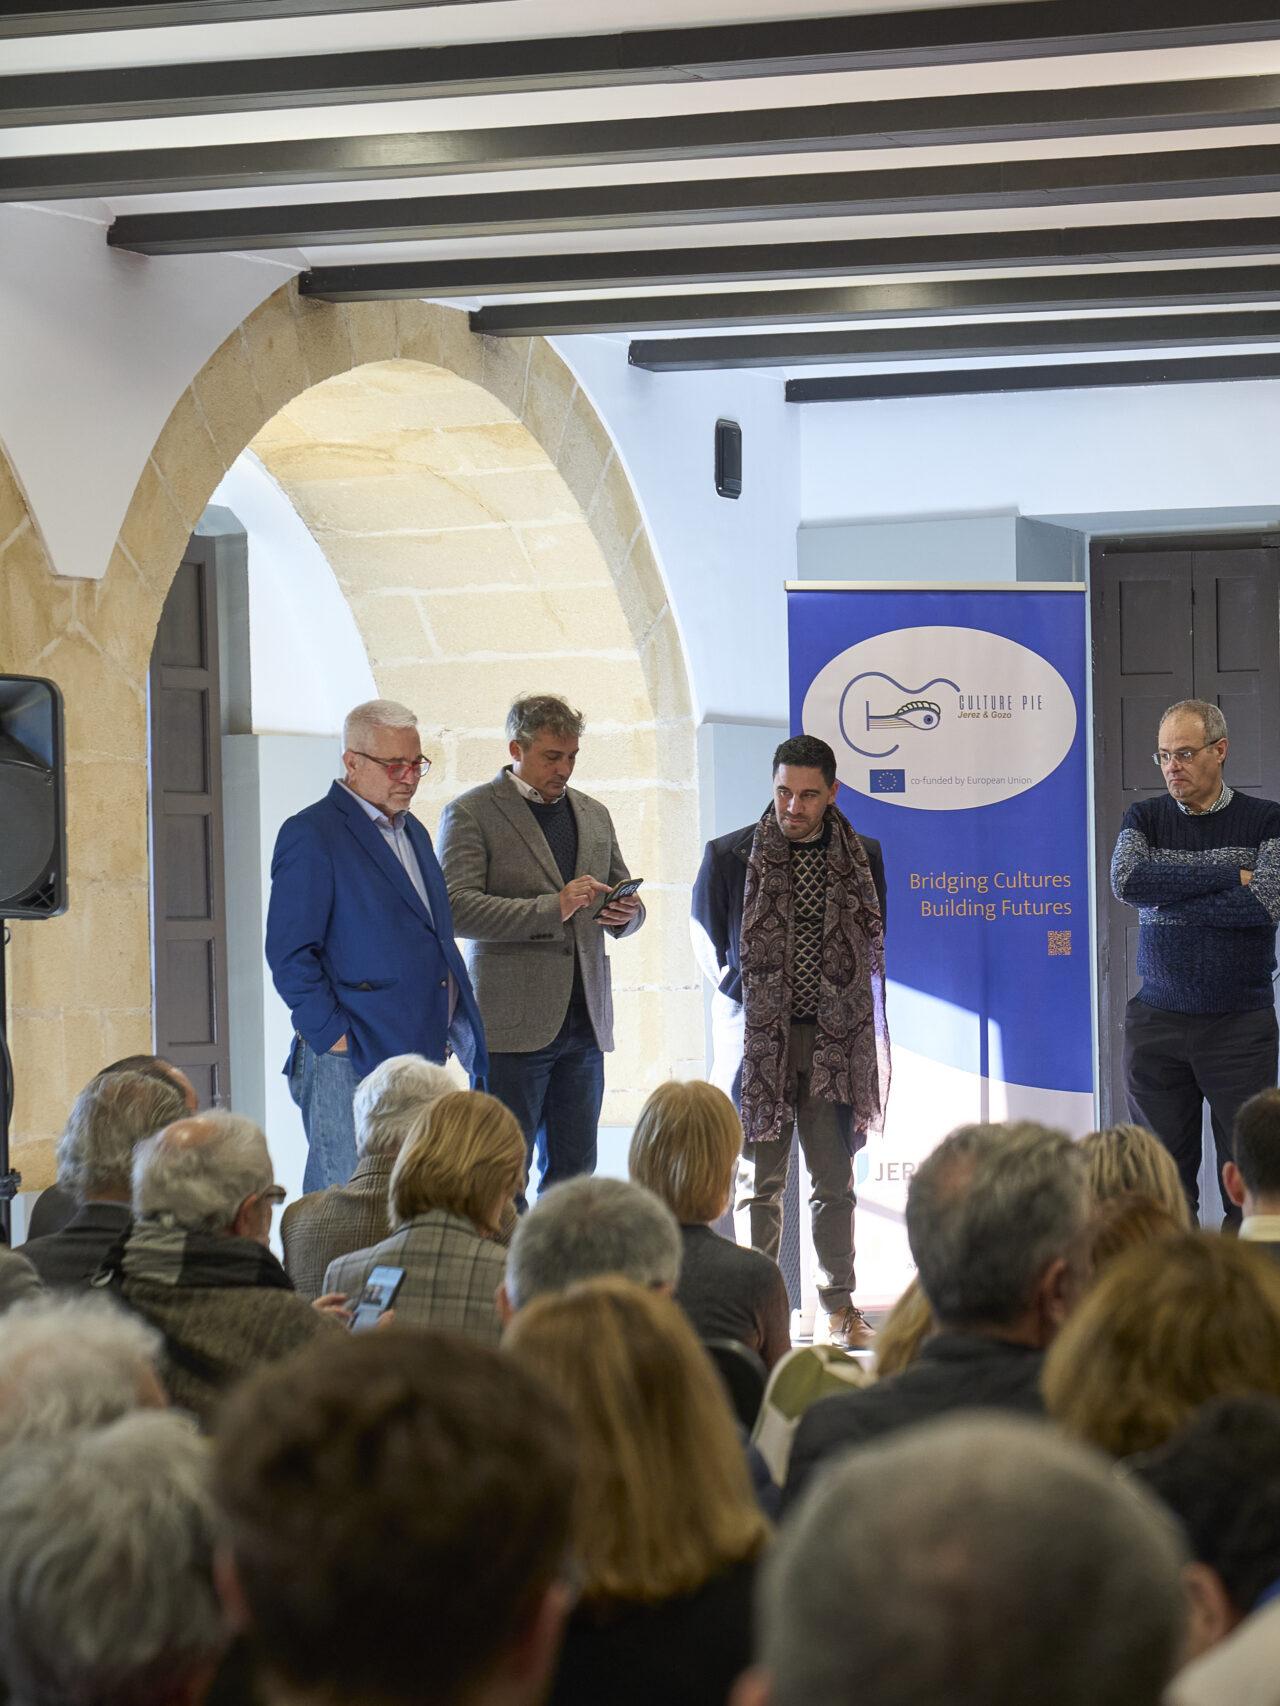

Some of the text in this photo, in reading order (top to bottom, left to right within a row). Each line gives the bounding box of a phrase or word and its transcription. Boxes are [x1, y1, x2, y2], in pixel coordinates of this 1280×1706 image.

[959, 694, 1042, 711] CULTURE PIE
[957, 711, 1012, 719] Jerez & Gozo
[910, 776, 1033, 786] co-funded by European Union
[910, 871, 1072, 894] Bridging Cultures
[921, 899, 1073, 921] Building Futures
[875, 1162, 915, 1181] JER
